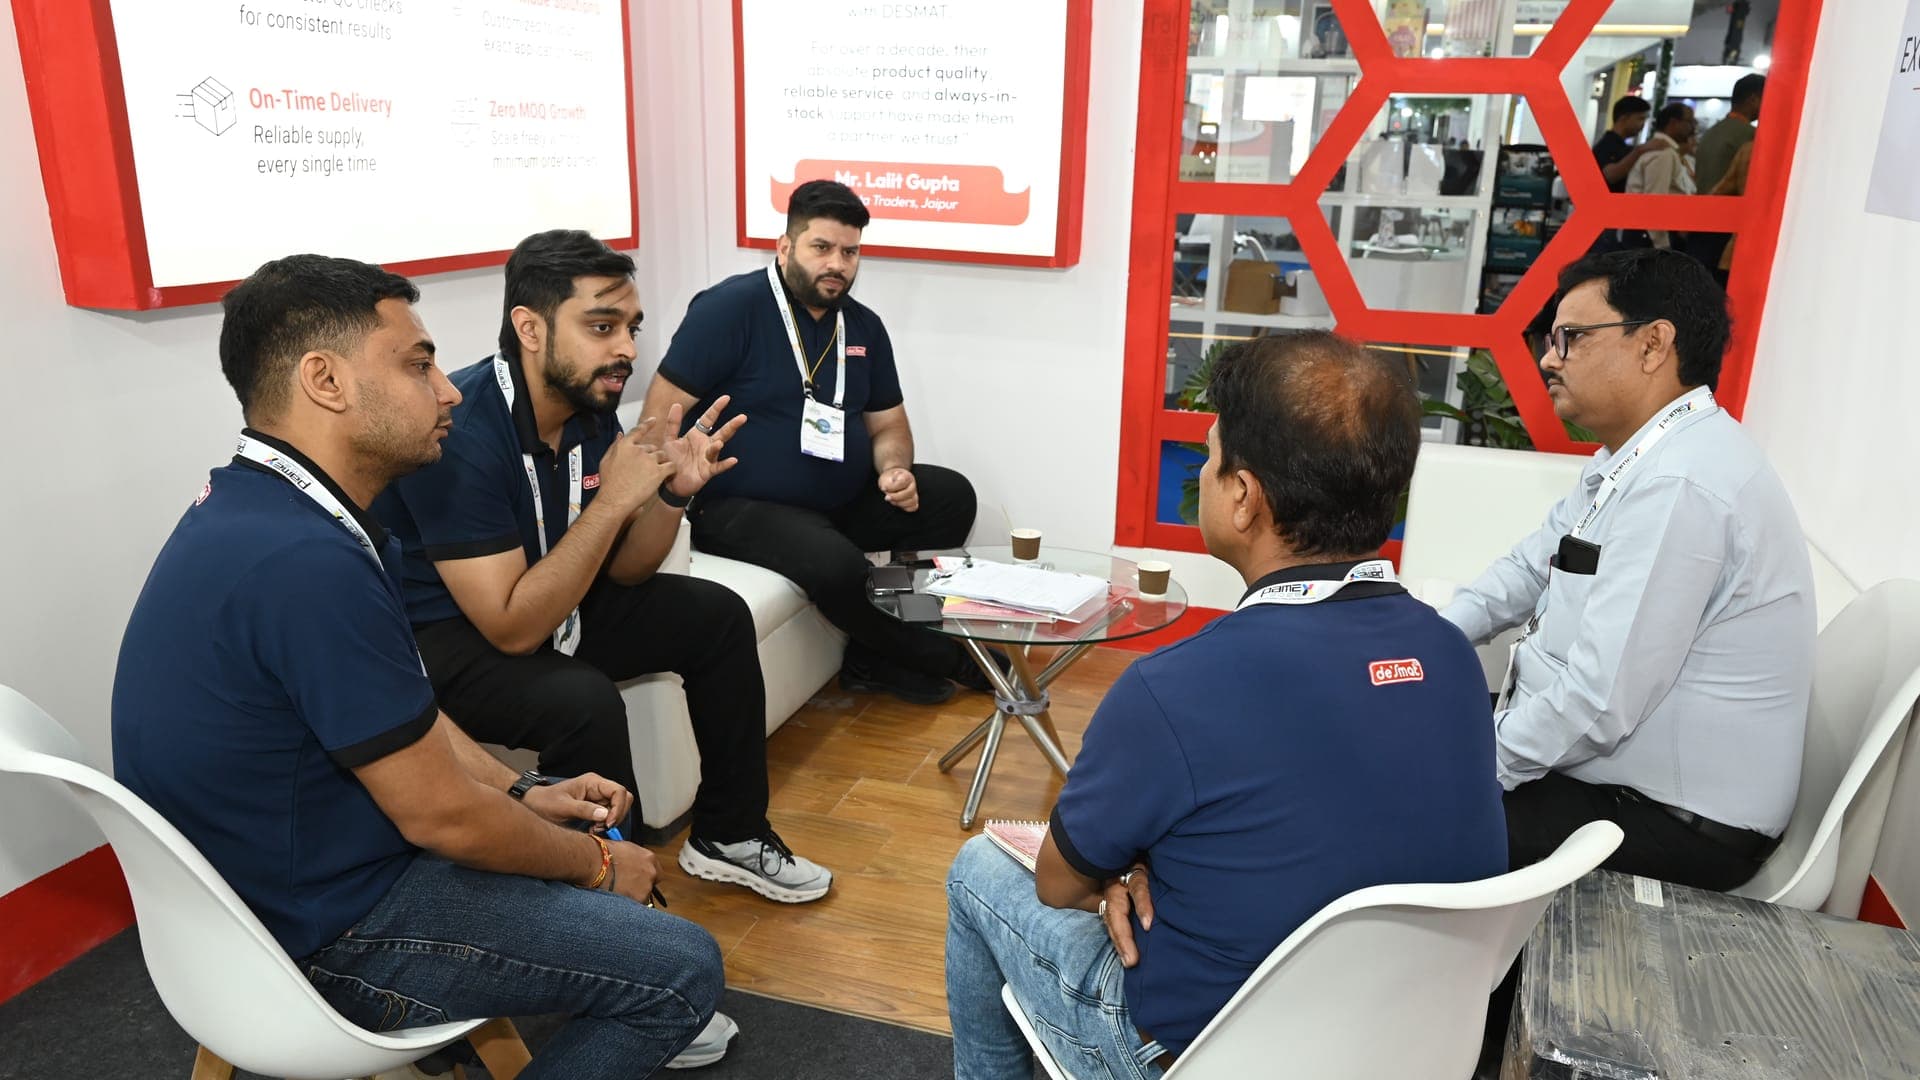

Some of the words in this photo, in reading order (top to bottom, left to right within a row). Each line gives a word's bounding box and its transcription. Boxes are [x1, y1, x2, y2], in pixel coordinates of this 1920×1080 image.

[239, 4, 262, 26] for
[266, 13, 344, 35] consistent
[348, 20, 392, 40] results
[1900, 36, 1920, 73] EX
[872, 65, 931, 80] product
[249, 87, 326, 111] On-Time
[330, 91, 392, 118] Delivery
[783, 84, 838, 99] reliable
[934, 87, 1017, 104] always-in-
[488, 100, 517, 118] Zero
[519, 101, 546, 121] MOQ
[787, 105, 824, 120] stock
[927, 109, 970, 124] made
[975, 111, 1015, 125] them
[254, 124, 313, 144] Reliable
[317, 126, 364, 149] supply,
[257, 157, 297, 178] every
[302, 152, 344, 177] single
[347, 155, 377, 172] time
[834, 170, 862, 187] Mr.
[866, 172, 903, 190] Lalit
[905, 173, 960, 195] Gupta
[873, 194, 918, 209] Traders,
[921, 197, 959, 212] Jaipur
